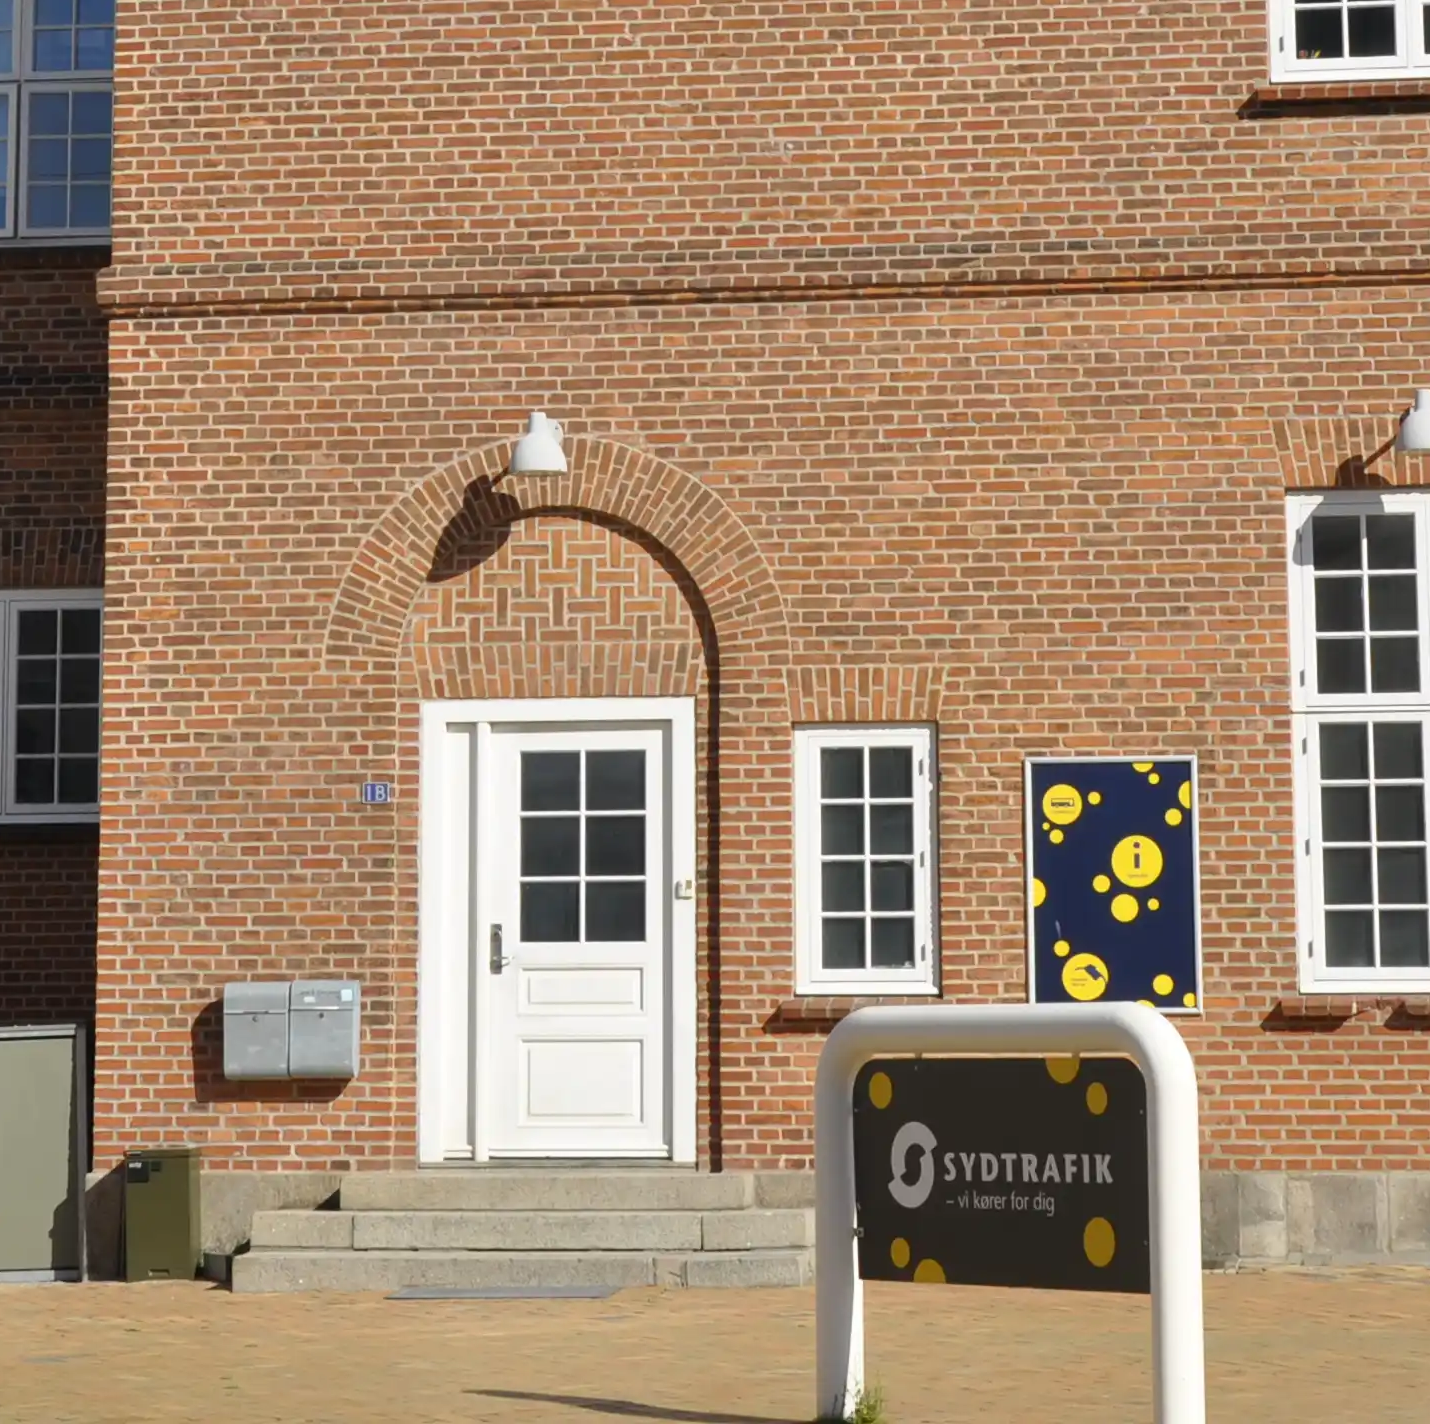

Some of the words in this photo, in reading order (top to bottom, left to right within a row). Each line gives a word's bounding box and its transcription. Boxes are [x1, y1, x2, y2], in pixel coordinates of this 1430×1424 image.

[943, 1152, 1114, 1184] SYDTRAFIK
[958, 1190, 969, 1209] vi
[973, 1191, 1006, 1211] kører
[1011, 1191, 1029, 1210] for
[1033, 1192, 1055, 1217] dig
